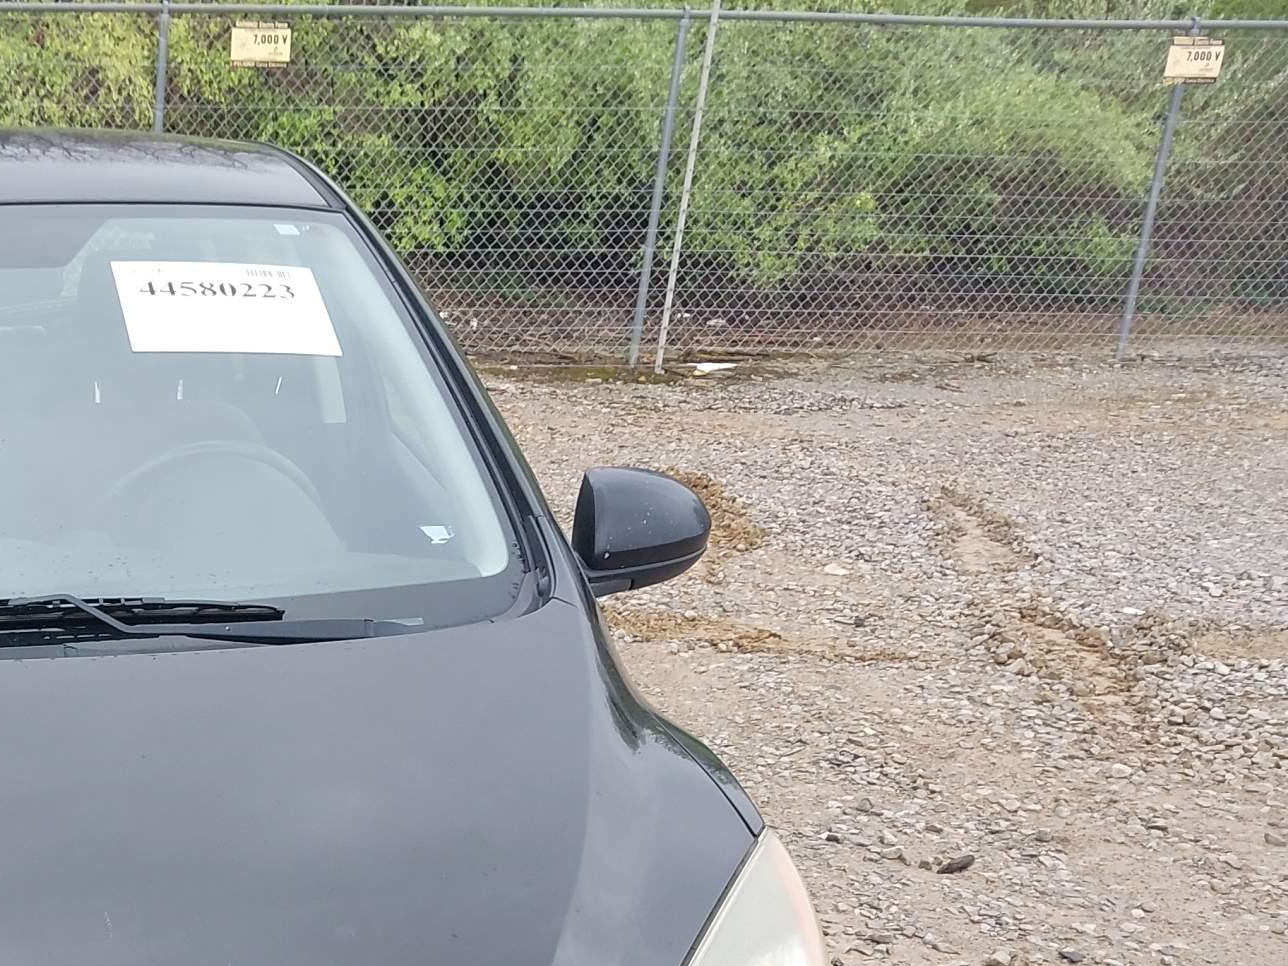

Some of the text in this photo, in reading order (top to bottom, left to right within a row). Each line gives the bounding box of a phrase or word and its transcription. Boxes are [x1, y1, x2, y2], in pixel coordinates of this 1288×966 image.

[253, 34, 288, 46] 7,000 V
[1186, 51, 1221, 62] 7,000 V
[139, 281, 295, 299] 44580223
